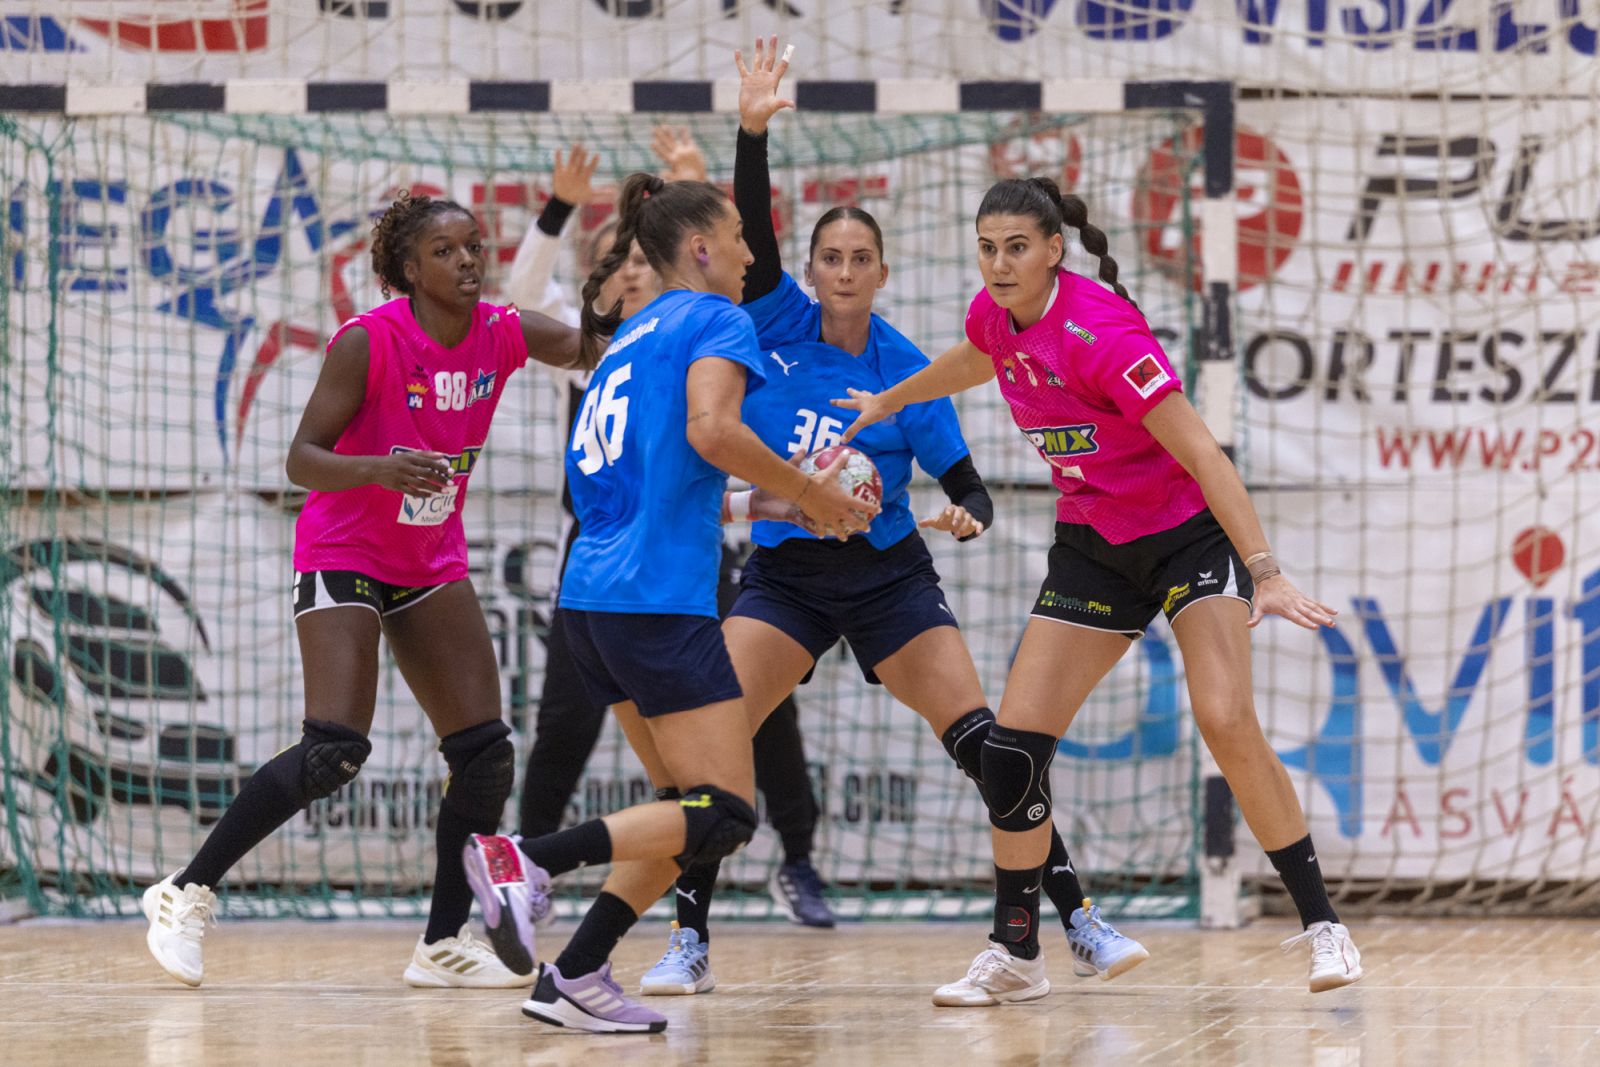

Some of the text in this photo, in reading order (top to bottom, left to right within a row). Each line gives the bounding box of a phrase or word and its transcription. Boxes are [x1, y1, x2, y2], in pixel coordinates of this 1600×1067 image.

[434, 371, 467, 411] 98
[572, 362, 632, 476] 96
[787, 408, 844, 454] 36
[1376, 427, 1600, 471] WWW.P2
[1197, 578, 1218, 587] erima
